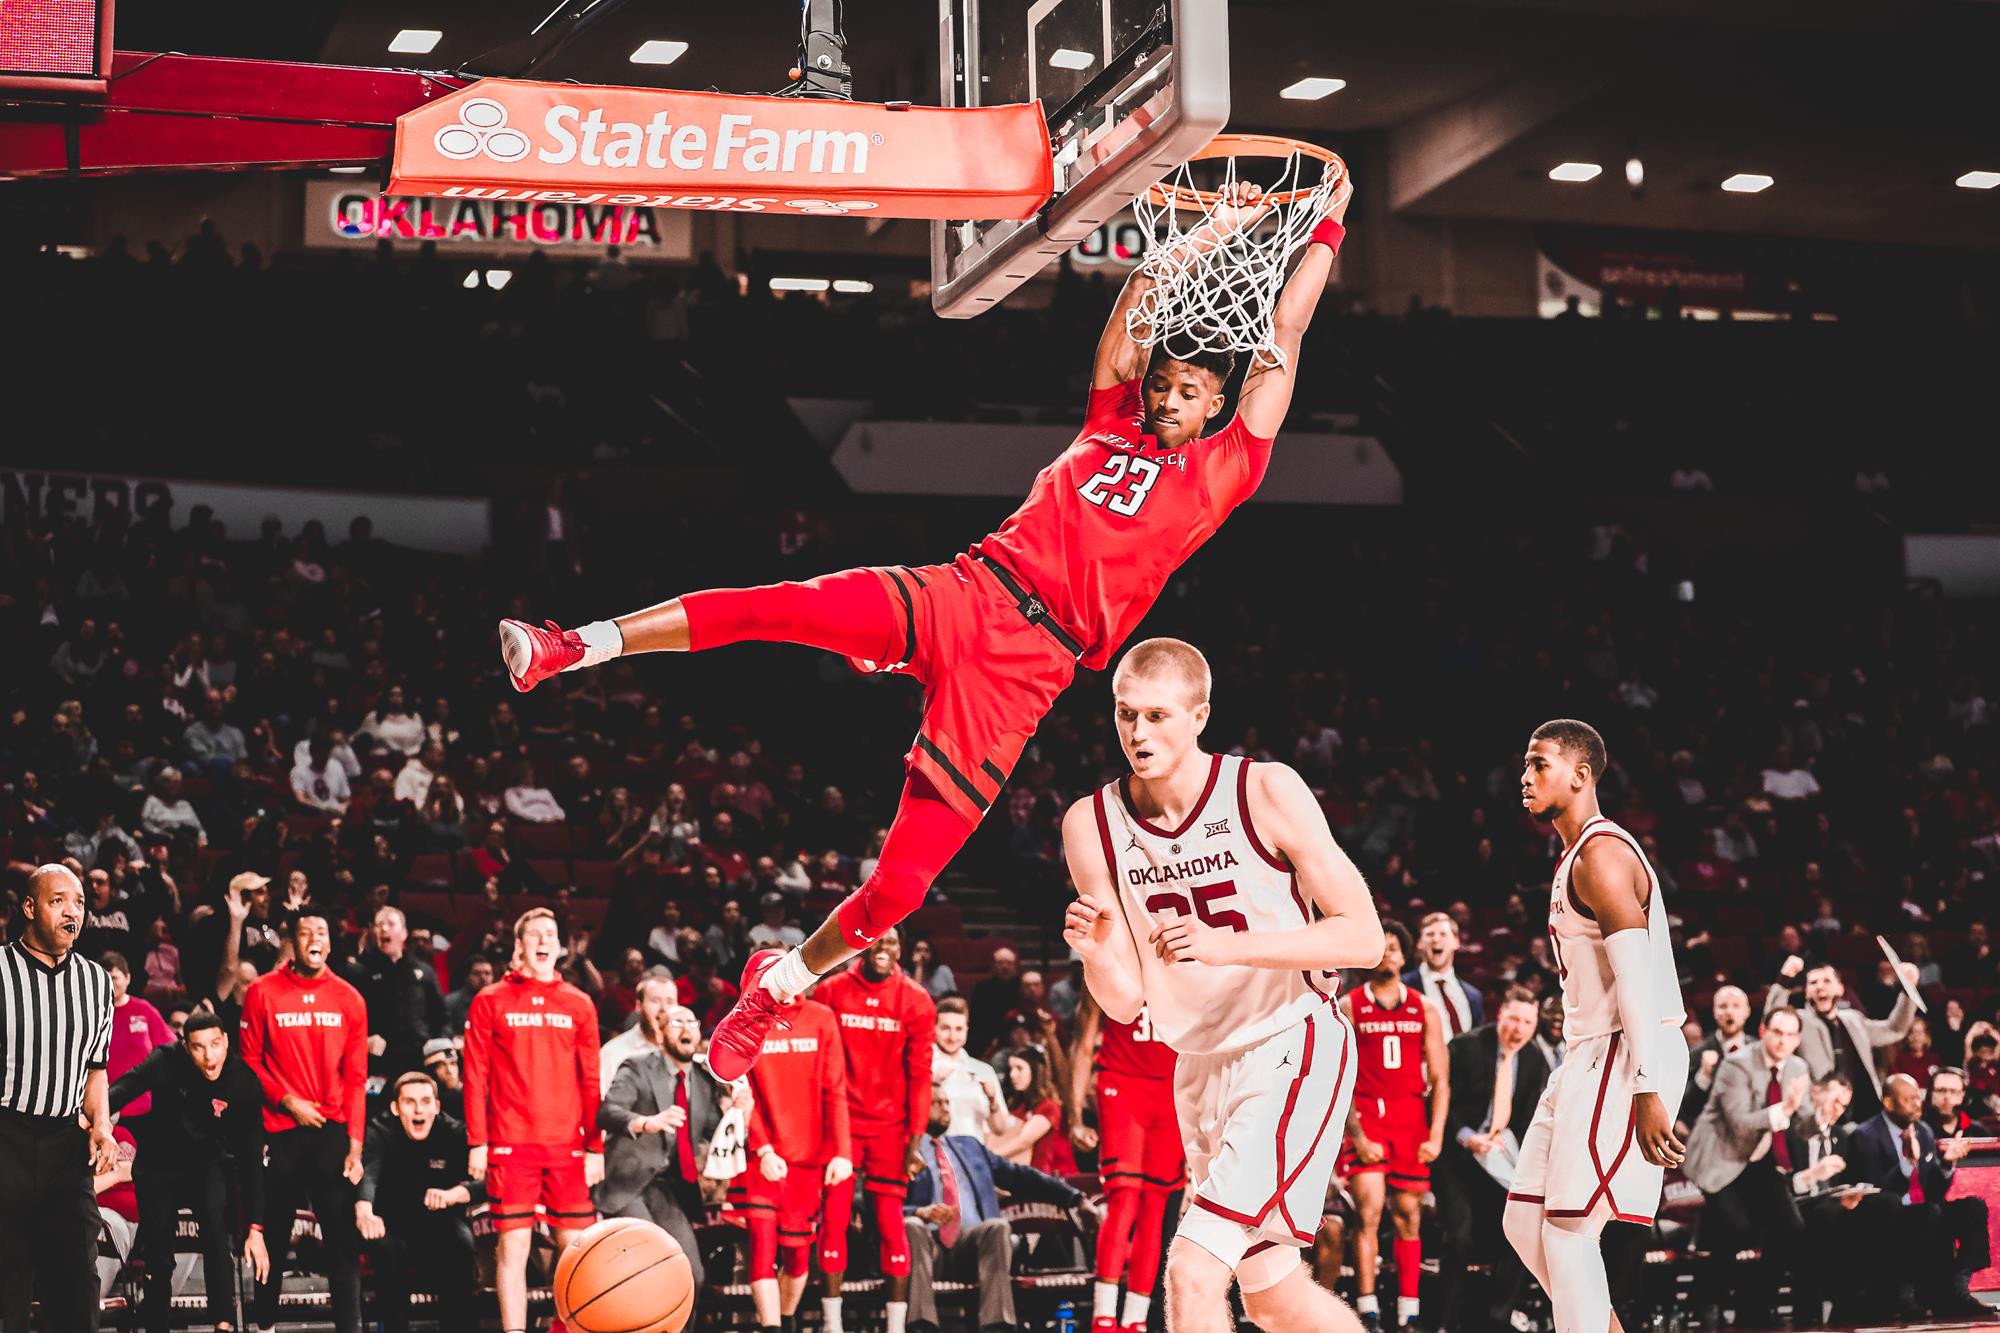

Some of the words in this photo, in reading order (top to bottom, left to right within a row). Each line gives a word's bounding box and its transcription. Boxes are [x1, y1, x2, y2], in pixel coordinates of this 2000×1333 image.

[332, 189, 661, 245] OKLAHOMA
[1078, 452, 1162, 517] 23
[1128, 850, 1239, 885] OKLAHOMA
[275, 1012, 312, 1028] TEXAS
[313, 1012, 342, 1027] TECH
[505, 1013, 543, 1027] TEXAS
[544, 1013, 573, 1029] TECH
[762, 1038, 789, 1054] EXAS
[1383, 1035, 1402, 1070] 0
